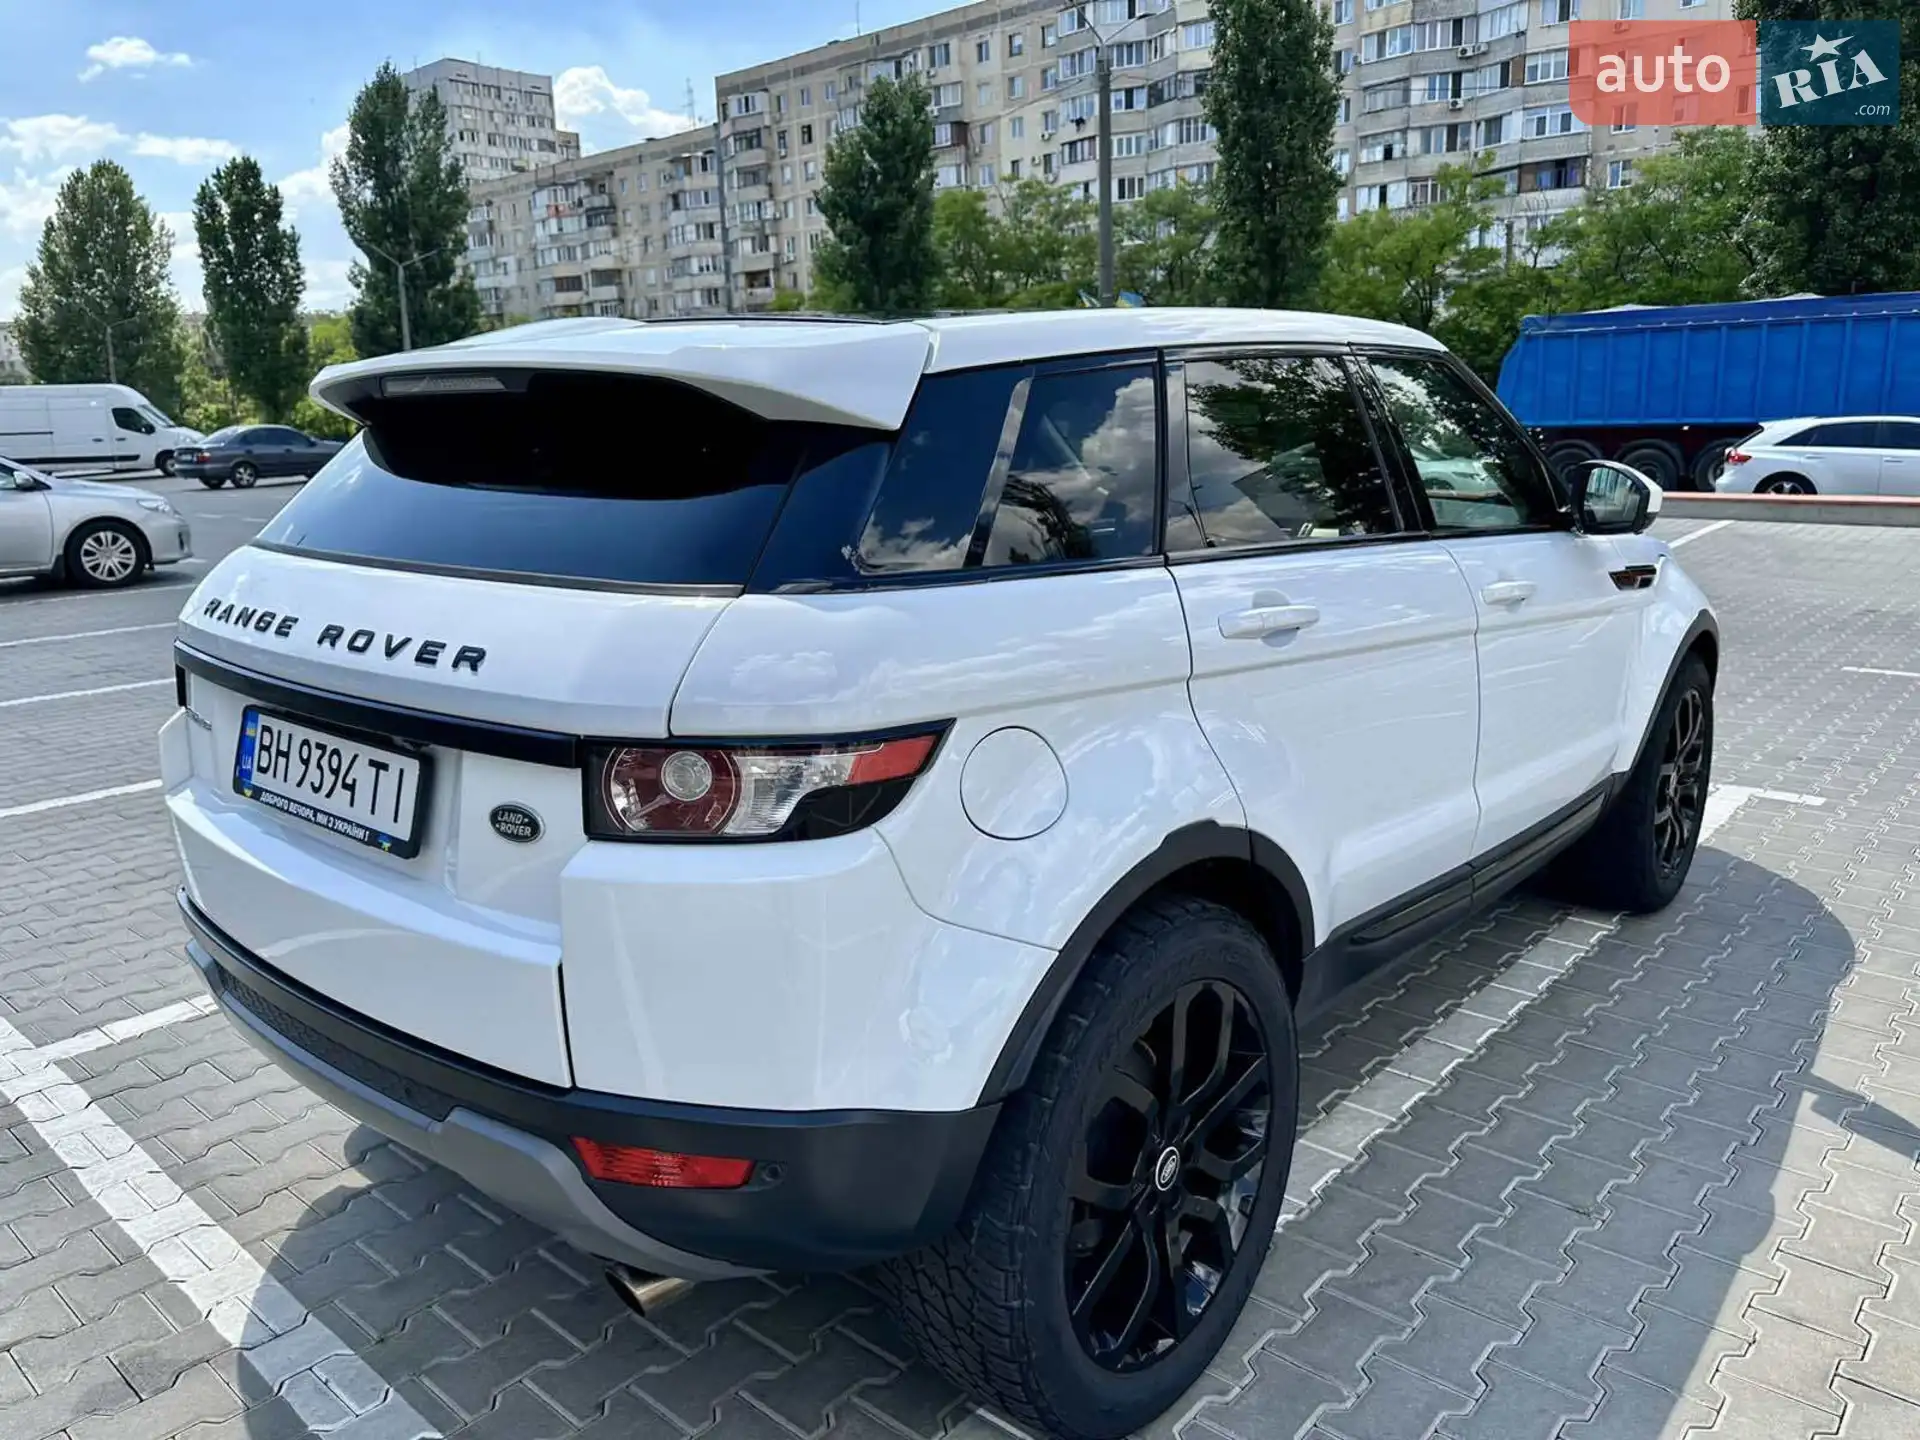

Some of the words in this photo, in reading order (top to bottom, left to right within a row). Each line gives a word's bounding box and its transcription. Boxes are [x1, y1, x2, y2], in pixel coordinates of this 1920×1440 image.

[204, 597, 299, 638] RANGE
[317, 623, 488, 672] ROVER
[241, 755, 252, 771] UA
[260, 791, 289, 812] ДОБРОГО
[495, 809, 523, 824] LAND
[499, 821, 531, 837] ROVER
